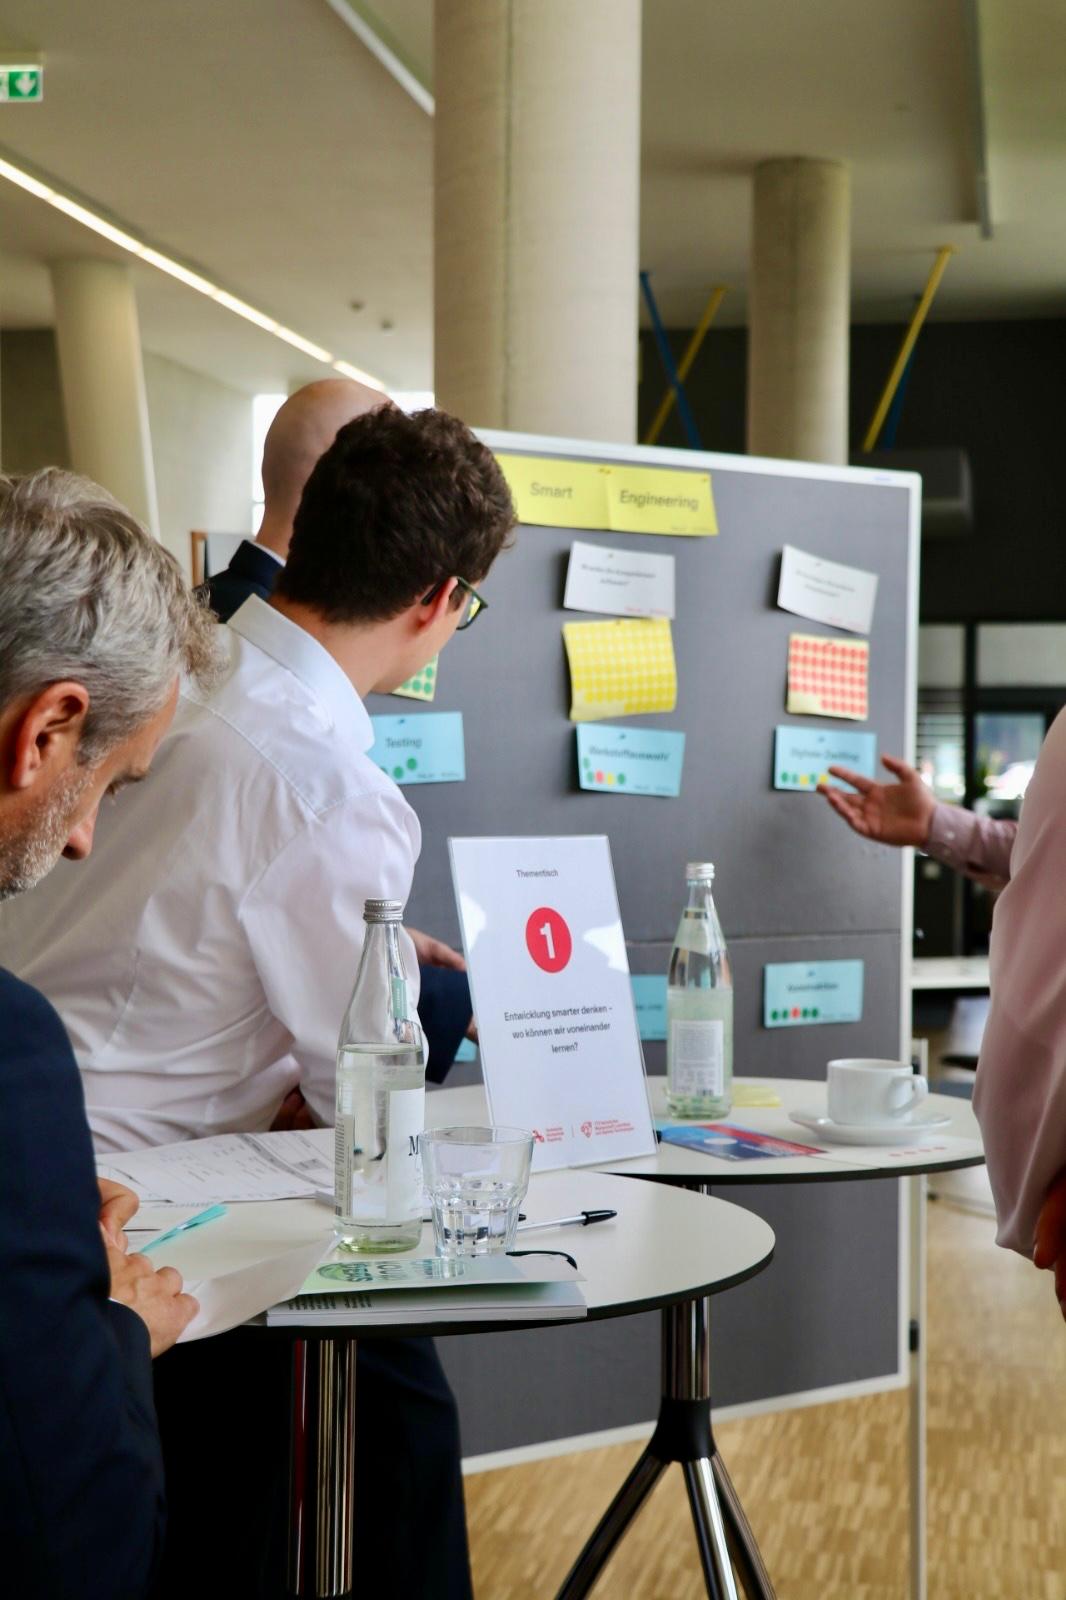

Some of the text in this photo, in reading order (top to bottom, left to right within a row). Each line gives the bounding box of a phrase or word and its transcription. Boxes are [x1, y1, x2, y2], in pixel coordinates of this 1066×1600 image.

[530, 482, 699, 511] Smart Engineering
[386, 738, 423, 750] Testing
[516, 869, 559, 878] Thementisch
[540, 922, 556, 959] 1
[504, 1010, 551, 1021] Entwicklung
[551, 1007, 580, 1018] smarter
[581, 1005, 607, 1015] denken
[512, 1022, 611, 1039] wo können wir voneinander
[551, 1042, 579, 1053] lernen?
